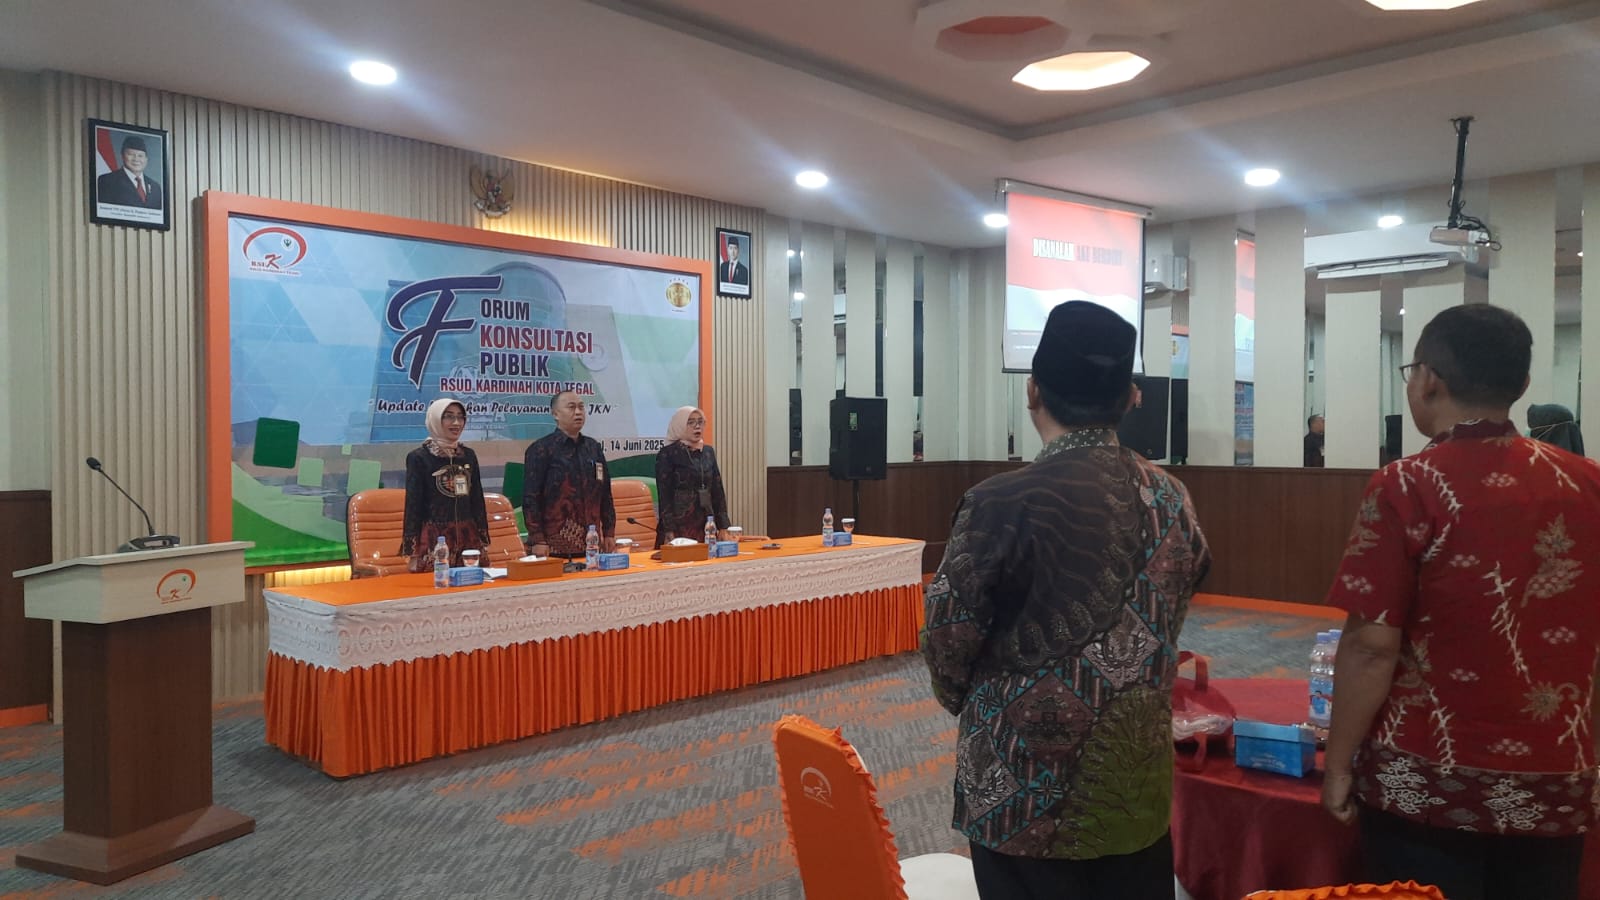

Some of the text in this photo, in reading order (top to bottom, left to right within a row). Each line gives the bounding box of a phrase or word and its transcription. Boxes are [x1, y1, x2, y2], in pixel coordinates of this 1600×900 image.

[480, 324, 592, 353] KONSULTASI
[480, 352, 549, 377] PUBLIK
[441, 377, 472, 392] RSUD
[476, 379, 532, 393] KARDINAH
[536, 381, 561, 394] KOTA
[491, 402, 550, 415] Pelayanan
[611, 440, 621, 451] 14
[623, 440, 642, 451] Juni
[644, 440, 665, 451] 2025
